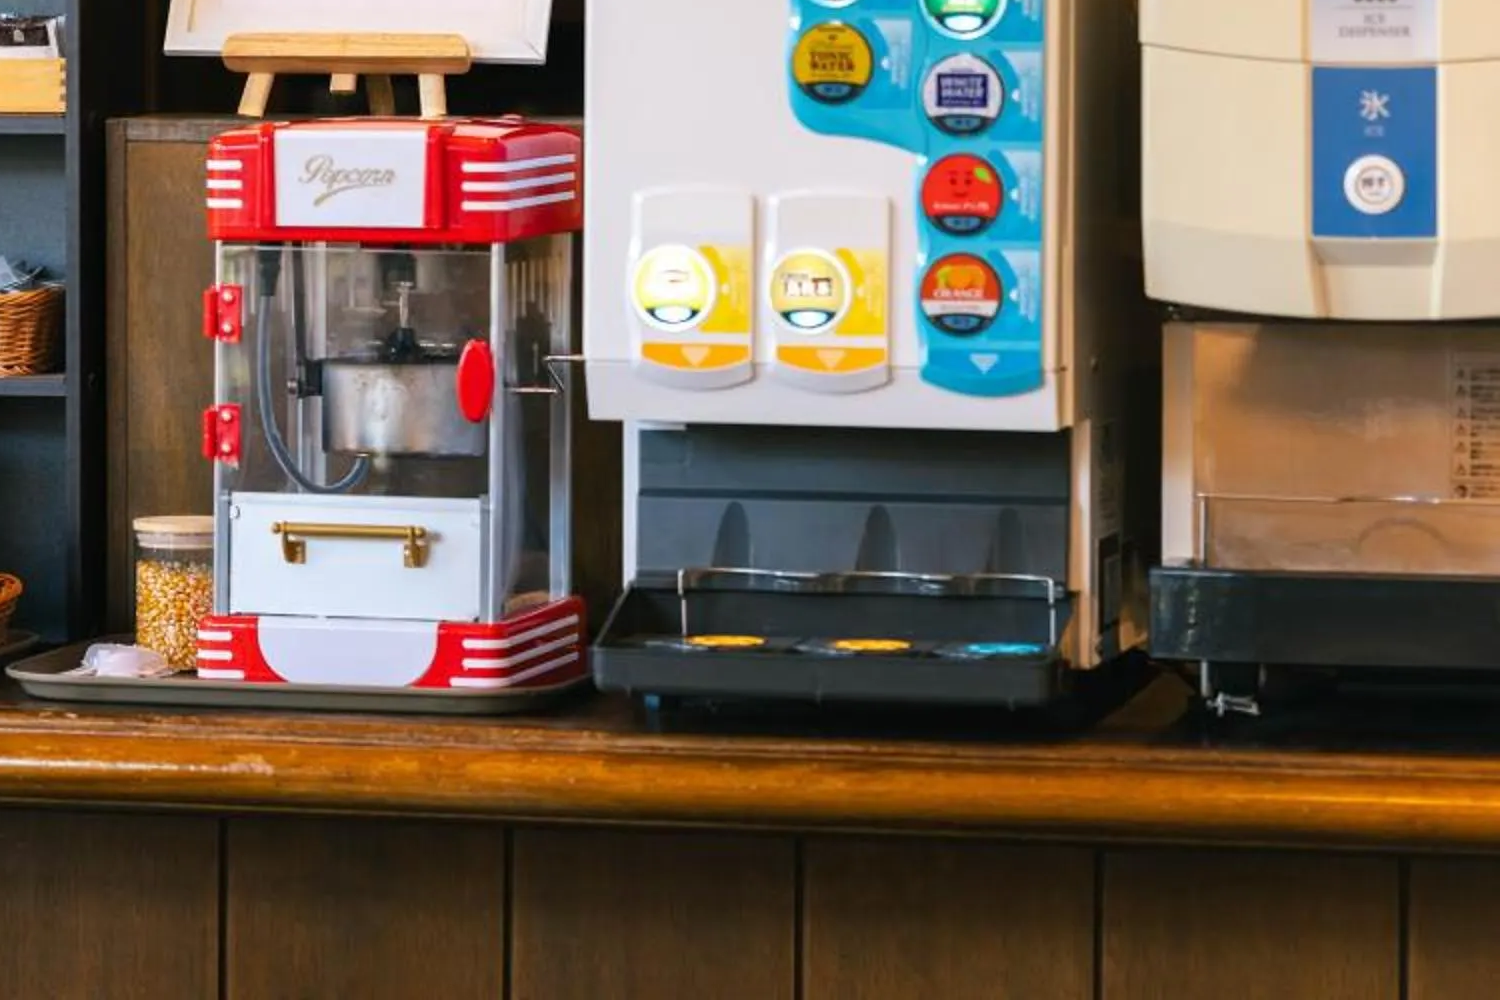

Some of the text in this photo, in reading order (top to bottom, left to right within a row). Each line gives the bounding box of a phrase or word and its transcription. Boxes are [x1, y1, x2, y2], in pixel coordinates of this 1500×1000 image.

[940, 87, 985, 99] WATER
[1358, 89, 1391, 121] 氷
[298, 154, 397, 206] Popcorn
[932, 287, 984, 298] ORANGE
